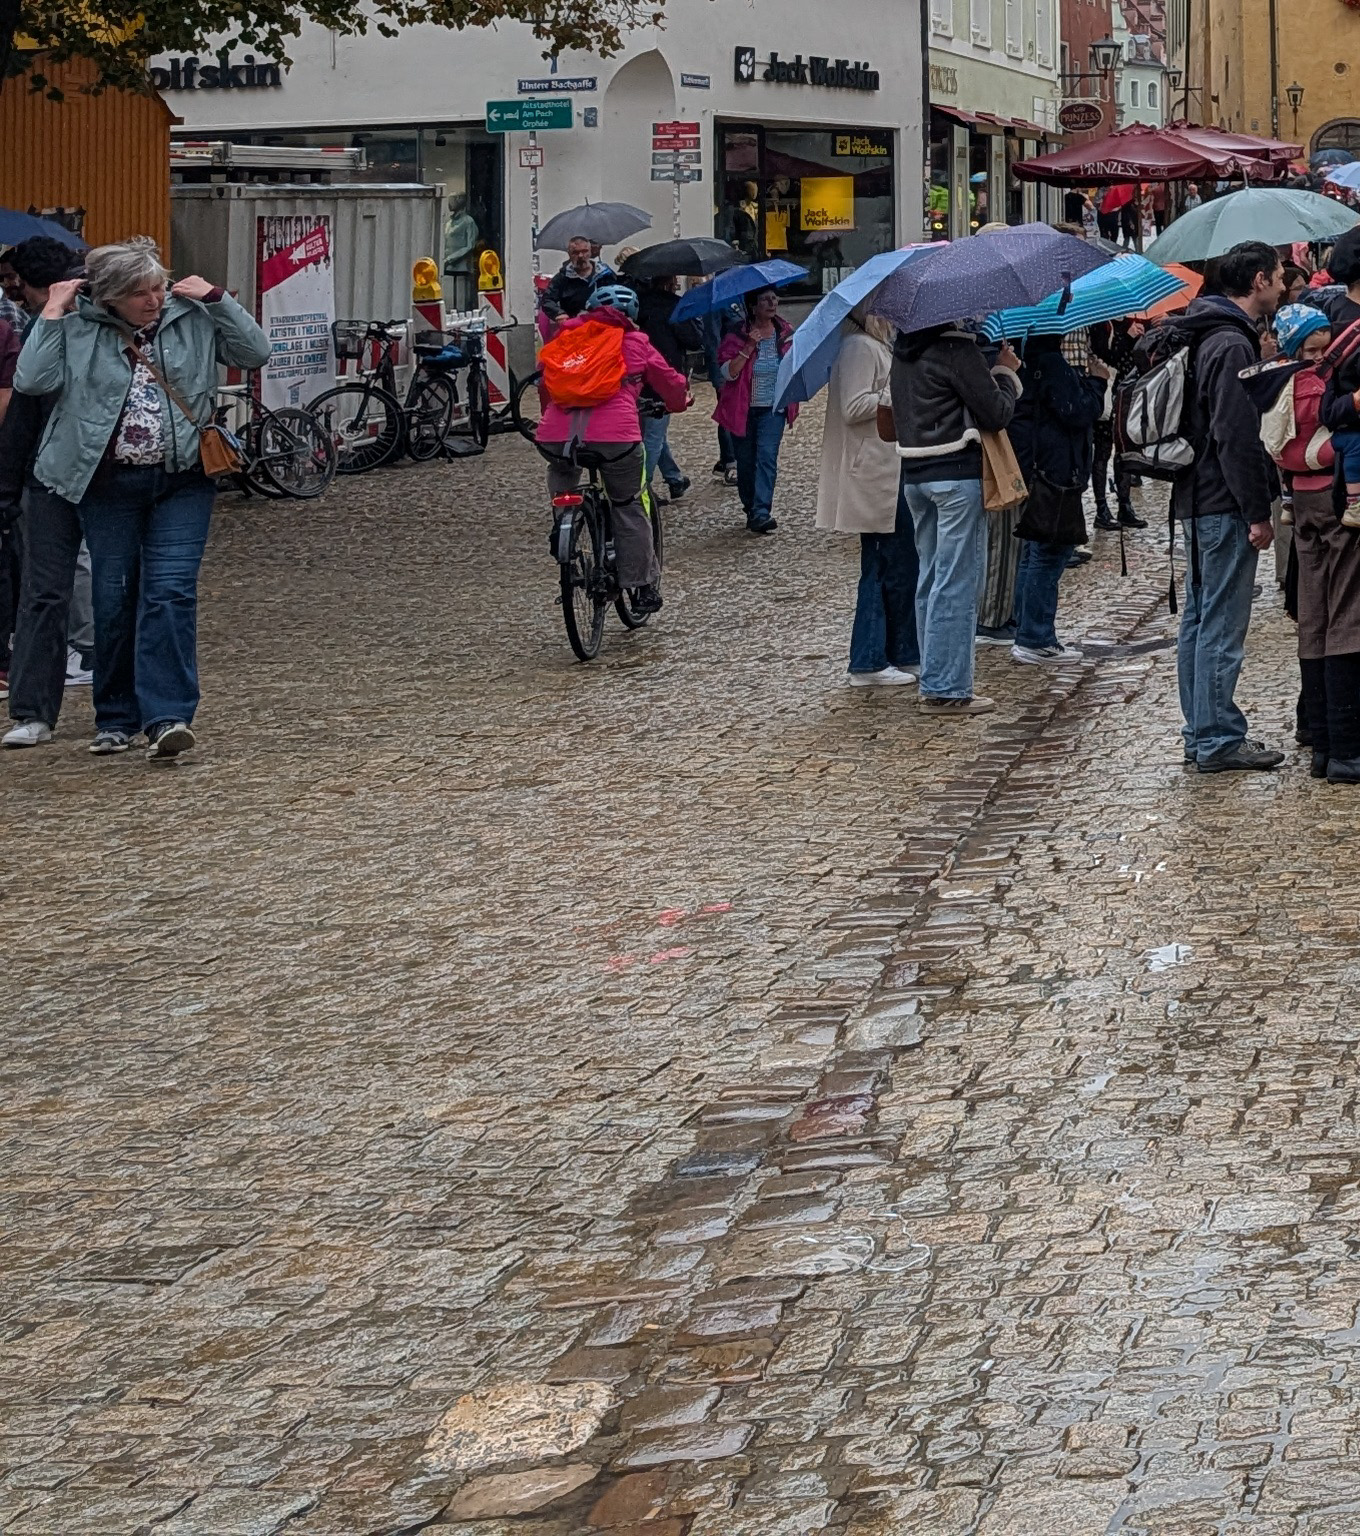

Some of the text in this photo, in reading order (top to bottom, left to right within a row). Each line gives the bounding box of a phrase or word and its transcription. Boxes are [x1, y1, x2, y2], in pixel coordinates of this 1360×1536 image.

[763, 52, 879, 90] Jack Wolfskin
[1060, 112, 1100, 124] PRINZESS
[852, 136, 871, 146] Jack
[852, 145, 887, 155] Wolfskin
[1080, 162, 1140, 177] PRINZESS
[804, 208, 828, 218] Jack
[804, 216, 850, 227] Wolfskin
[302, 324, 329, 335] THEATER
